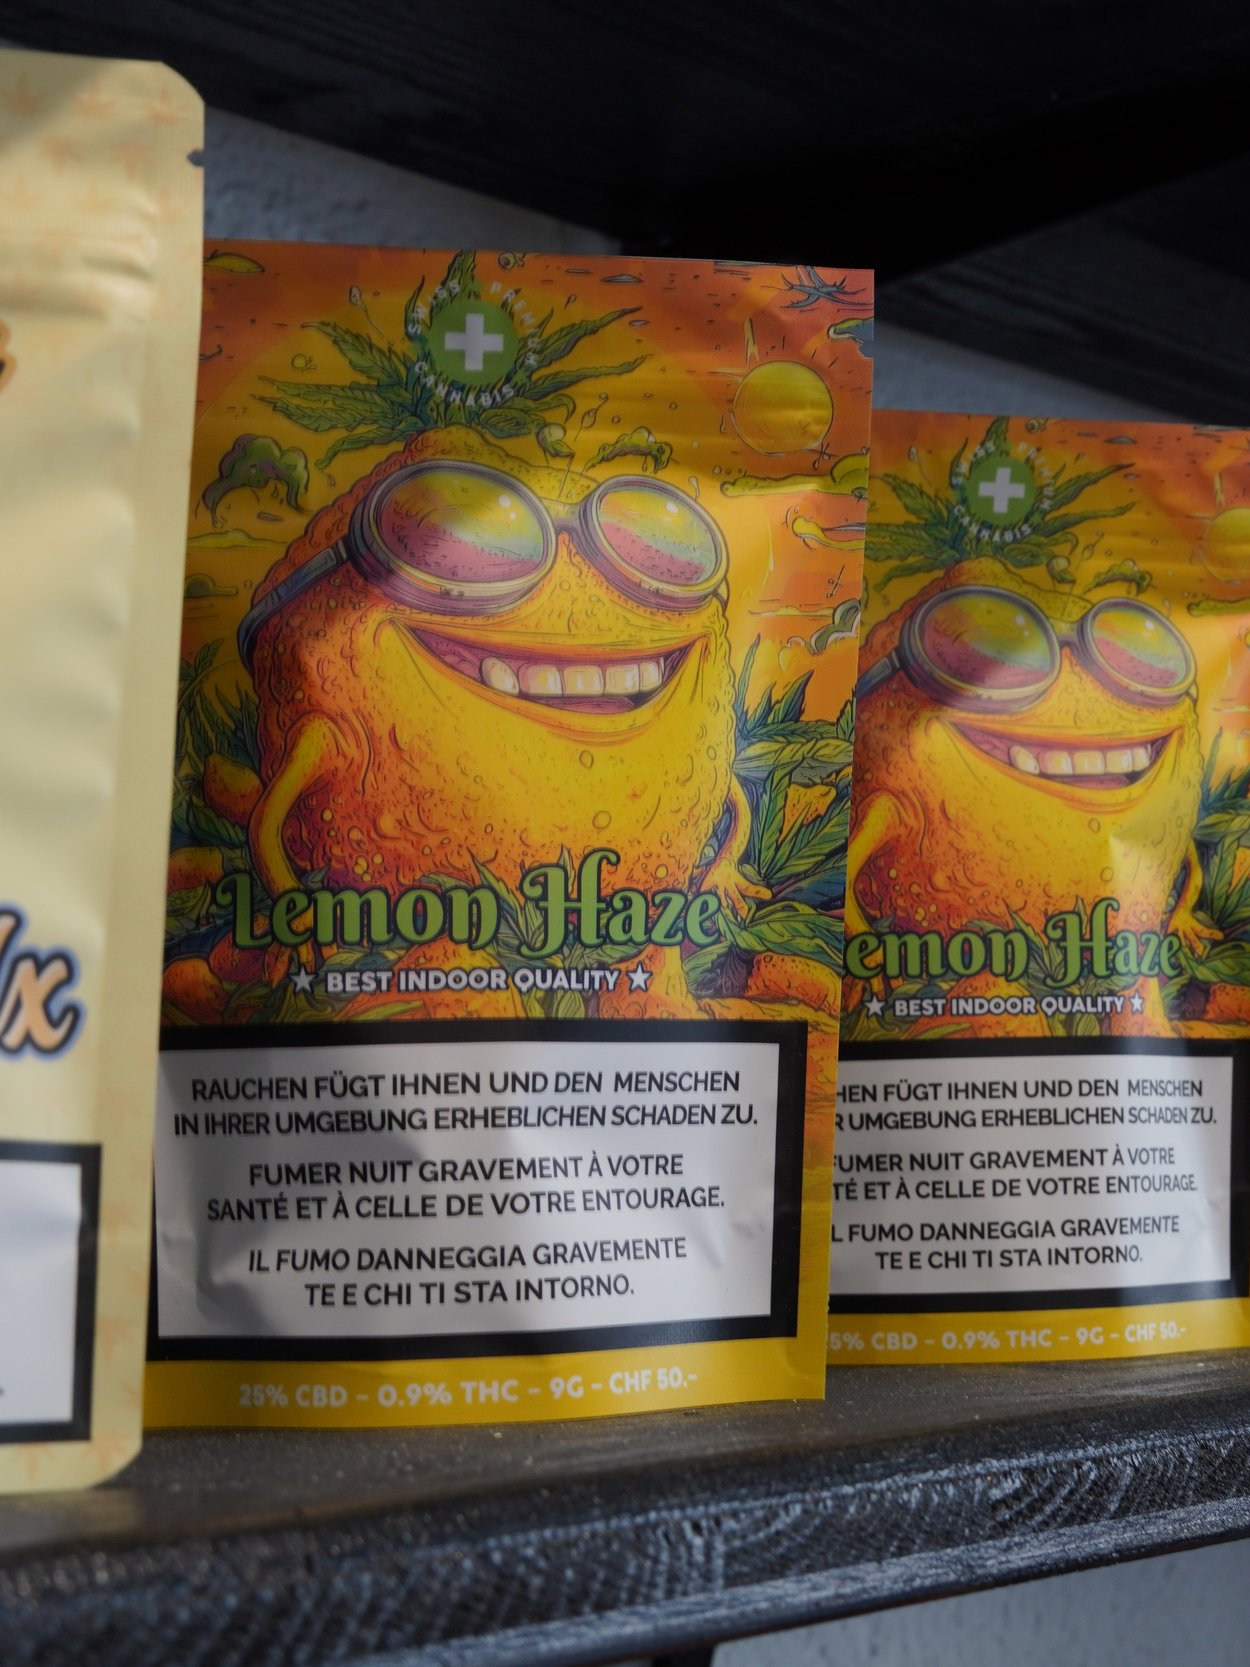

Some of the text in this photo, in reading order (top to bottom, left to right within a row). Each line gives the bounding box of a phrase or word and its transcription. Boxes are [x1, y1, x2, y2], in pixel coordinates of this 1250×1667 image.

[408, 279, 541, 368] SWISS PREMIUM
[414, 361, 515, 407] CANNABIS
[215, 847, 722, 960] Lemon Haze
[844, 898, 1183, 989] emon Haze
[327, 967, 621, 993] BEST INDOOR QUALITY
[894, 996, 1125, 1016] BEST INDOOR QUALITY
[192, 1070, 740, 1101] RAUCHEN FÜGT IHNEN UND DEN MENSCHEN
[883, 1079, 942, 1102] FÜGT
[948, 1081, 1017, 1100] IHNEN
[1023, 1080, 1073, 1098] UND
[1078, 1079, 1119, 1098] DEN
[1127, 1079, 1203, 1097] MENSCHEN
[173, 1103, 758, 1136] IN IHRER UMGEBUNG ERHEBLICHEN SCHADEN ZU.
[848, 1110, 976, 1131] UMGEBUNG
[981, 1107, 1124, 1128] ERHEBLICHEN
[1128, 1106, 1187, 1125] SCHADEN
[1190, 1106, 1217, 1125] ZU.
[249, 1150, 684, 1187] FUMER NUIT GRAVEMENT À VOTRE
[833, 1143, 1175, 1173] UMER NUIT GRAVEMENT À VOTRE
[864, 1181, 891, 1200] ET
[895, 1176, 911, 1199] À
[915, 1180, 985, 1199] CELLE
[992, 1179, 1021, 1197] DE
[1026, 1176, 1100, 1196] VOTRE
[1106, 1174, 1198, 1194] ENTOURAGE.
[207, 1185, 725, 1222] SANTÉ ET À CELLE DE VOTRE ENTOURAGE.
[848, 1223, 913, 1242] FUMO
[920, 1220, 1056, 1241] DANNEGGIA
[1061, 1215, 1180, 1237] GRAVEMENTE
[248, 1236, 687, 1272] IL FUMO DANNEGGIA GRAVEMENTE
[875, 1244, 1143, 1270] TE E CHI TI STA INTORNO.
[304, 1273, 634, 1306] TE E CHI TI STA INTORNO.
[827, 1331, 864, 1350] 5%
[870, 1332, 918, 1350] CBD
[941, 1330, 999, 1349] 0.9%
[1005, 1328, 1052, 1347] THC
[1076, 1326, 1104, 1345] 9G
[1124, 1322, 1156, 1343] CHF
[239, 1383, 288, 1408] 25%
[295, 1383, 348, 1408] CBD
[377, 1380, 453, 1407] 0.9%
[460, 1378, 519, 1403] THC
[549, 1375, 584, 1399] 9G
[608, 1368, 652, 1394] CHF
